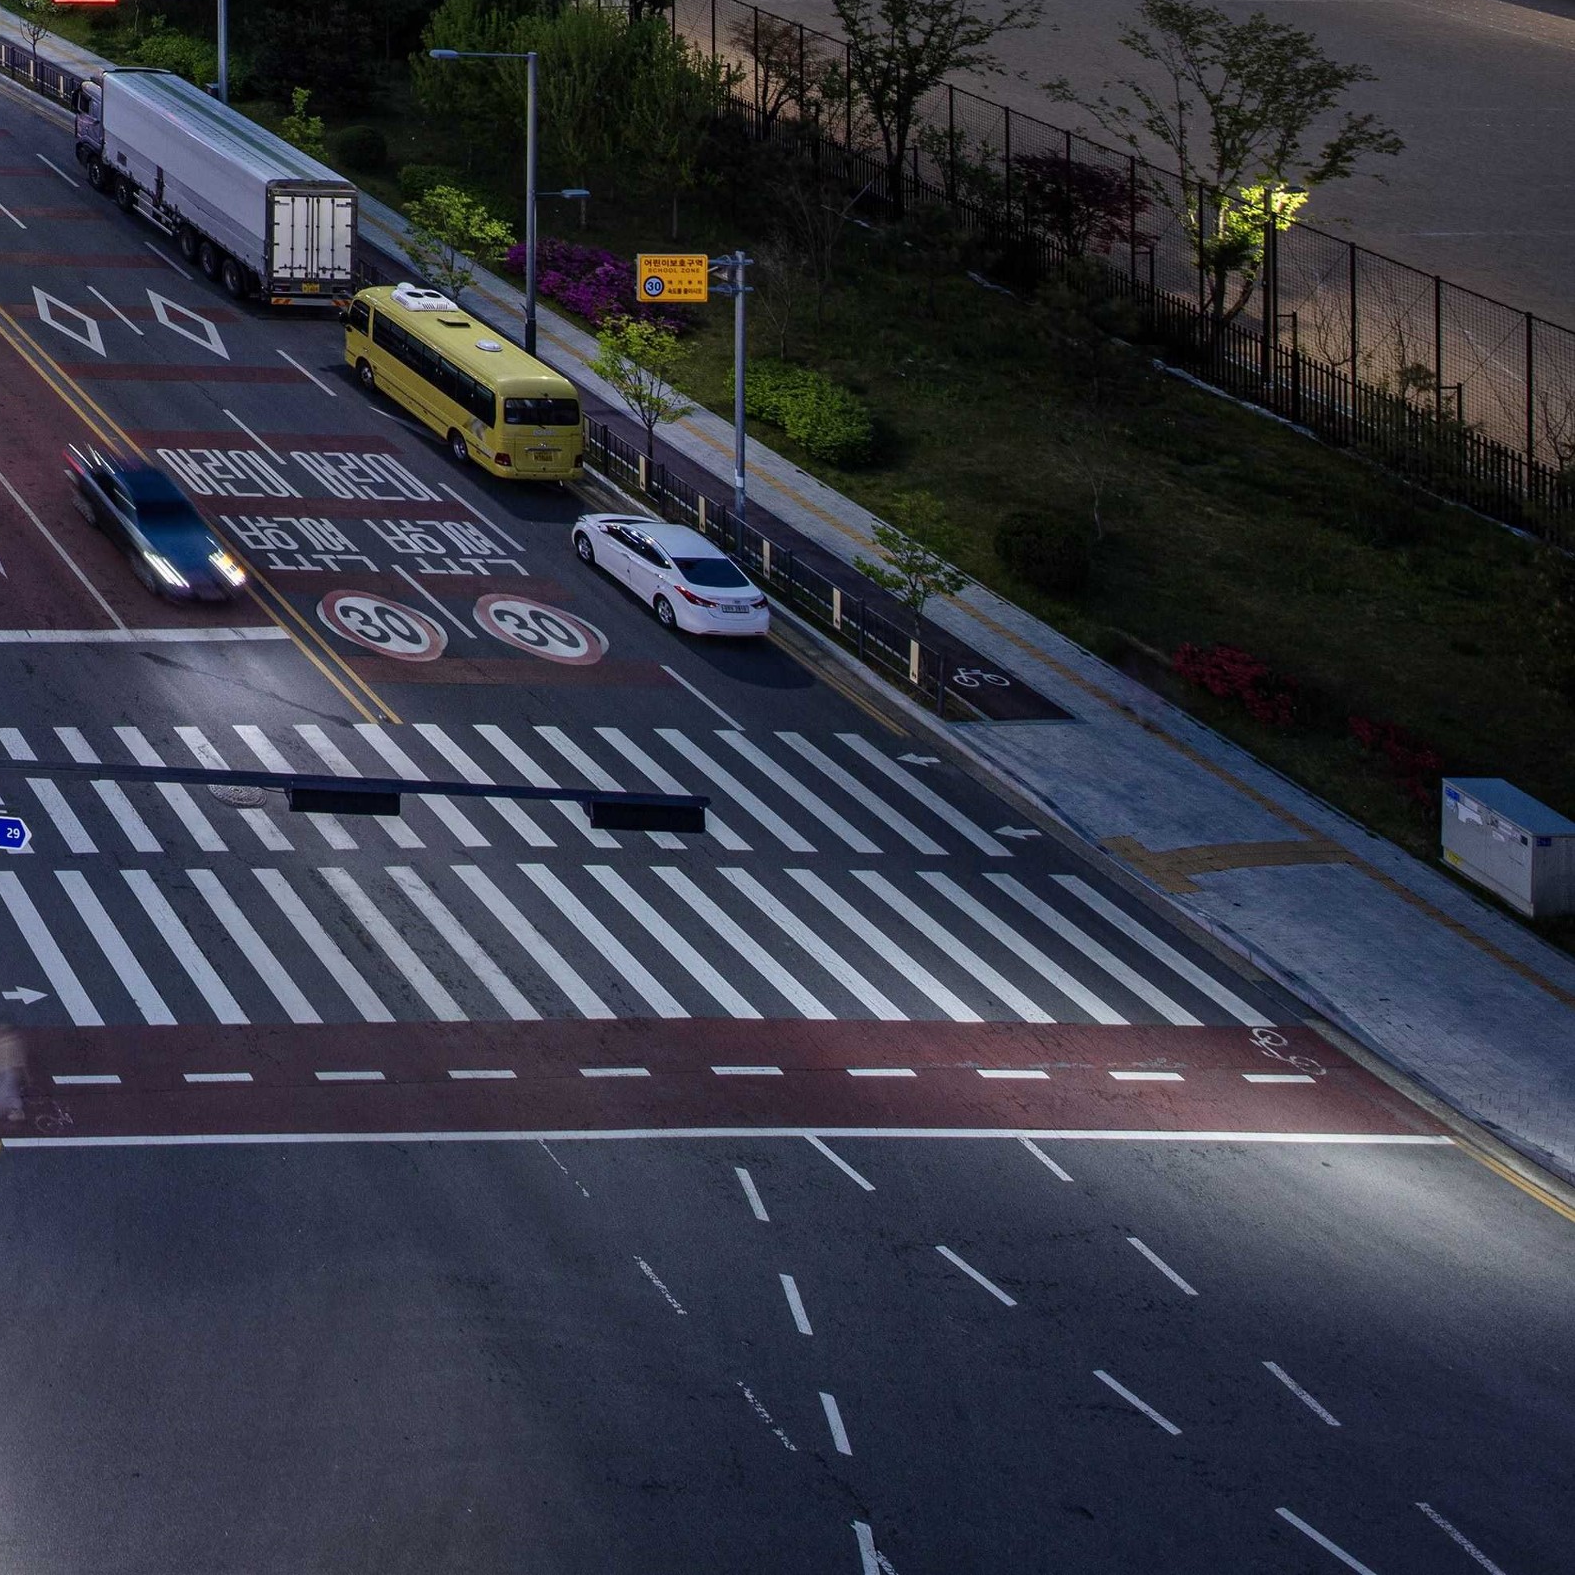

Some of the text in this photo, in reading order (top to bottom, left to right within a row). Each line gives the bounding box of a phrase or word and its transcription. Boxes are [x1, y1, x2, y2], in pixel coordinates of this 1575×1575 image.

[644, 258, 703, 268] 어린이보호구역
[647, 281, 661, 292] 30
[157, 448, 443, 503] 어린이 어린이
[338, 607, 423, 645] 30
[493, 608, 580, 647] 30
[6, 827, 20, 839] 29
